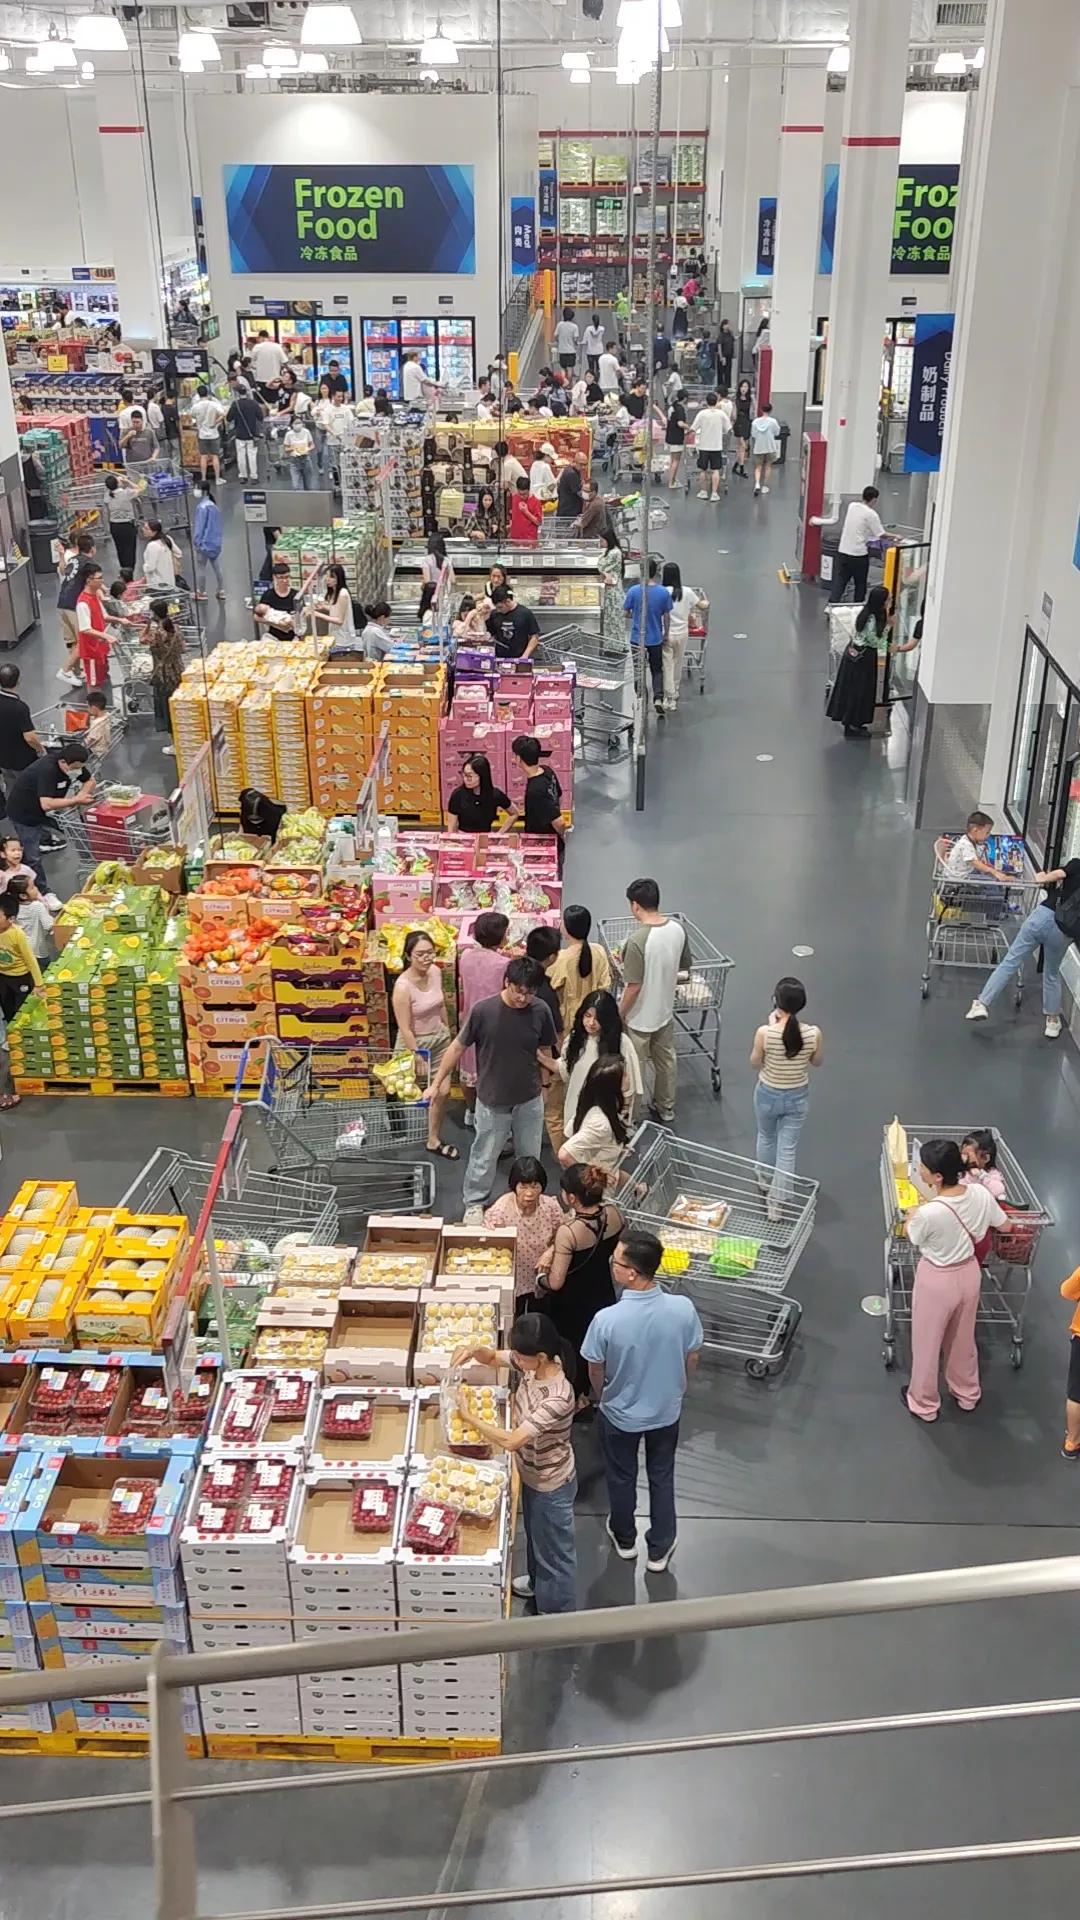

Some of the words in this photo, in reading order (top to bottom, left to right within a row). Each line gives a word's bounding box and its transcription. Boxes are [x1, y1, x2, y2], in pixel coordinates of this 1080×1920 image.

[294, 178, 404, 209] Frozen
[296, 209, 378, 240] Food
[523, 224, 532, 249] Meat
[300, 245, 358, 261] 冷冻食品
[892, 245, 951, 261] 冷冻食品
[919, 366, 938, 422] 奶制品
[215, 1016, 246, 1024] CITRUS
